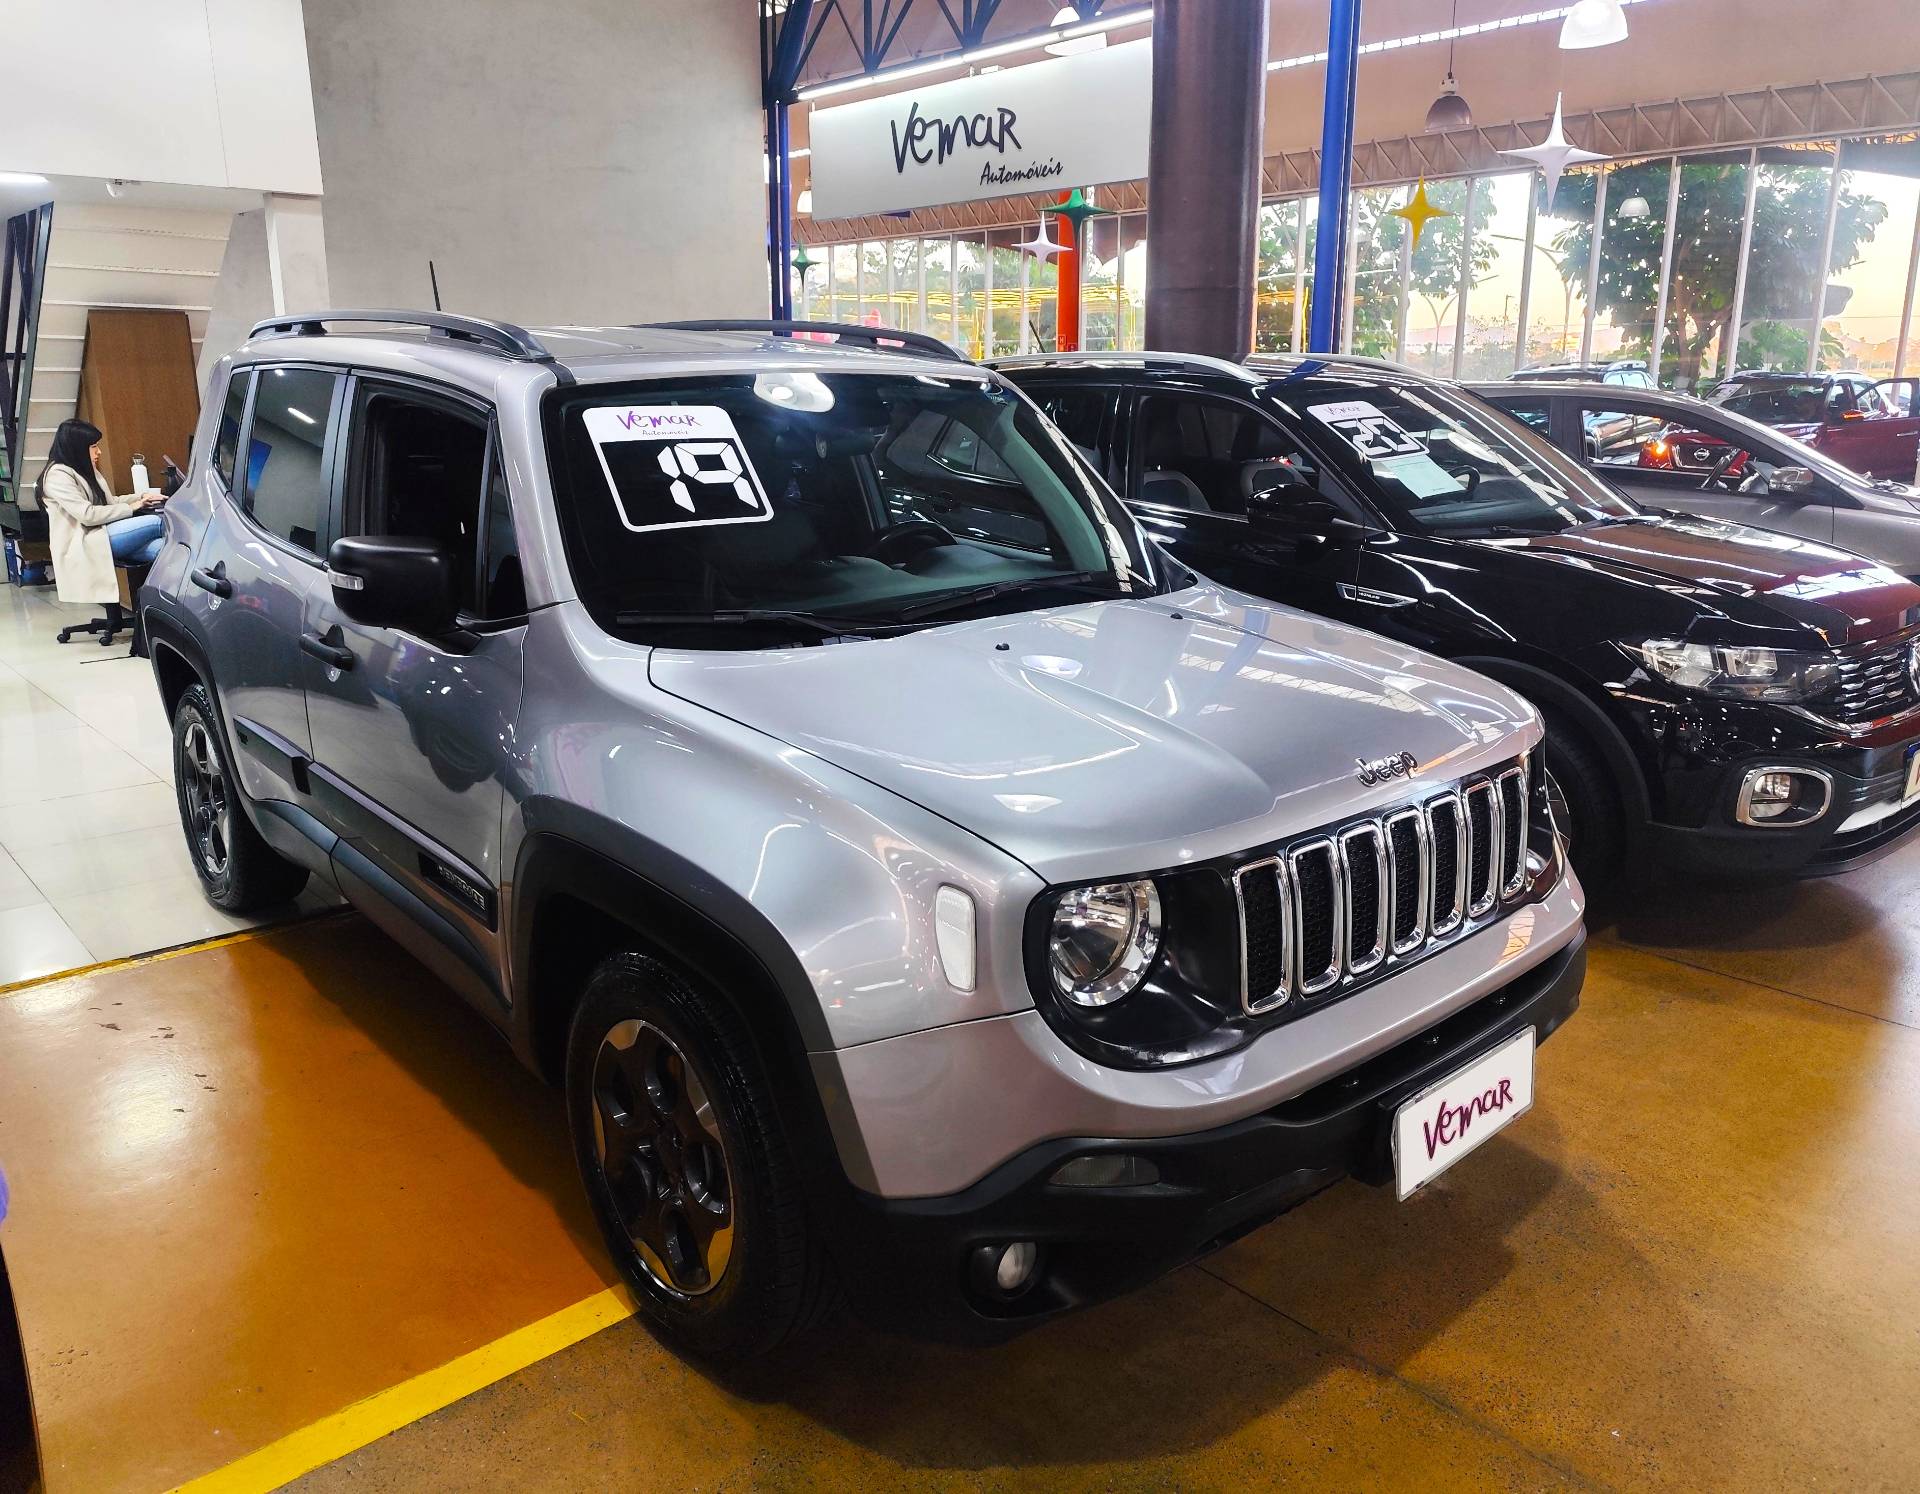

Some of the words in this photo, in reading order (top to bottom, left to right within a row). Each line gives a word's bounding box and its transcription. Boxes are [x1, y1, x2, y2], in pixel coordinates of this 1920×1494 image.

[980, 157, 1063, 187] Automóveis
[1333, 418, 1421, 456] 20
[657, 442, 759, 513] 19
[1355, 751, 1418, 788] Jeep
